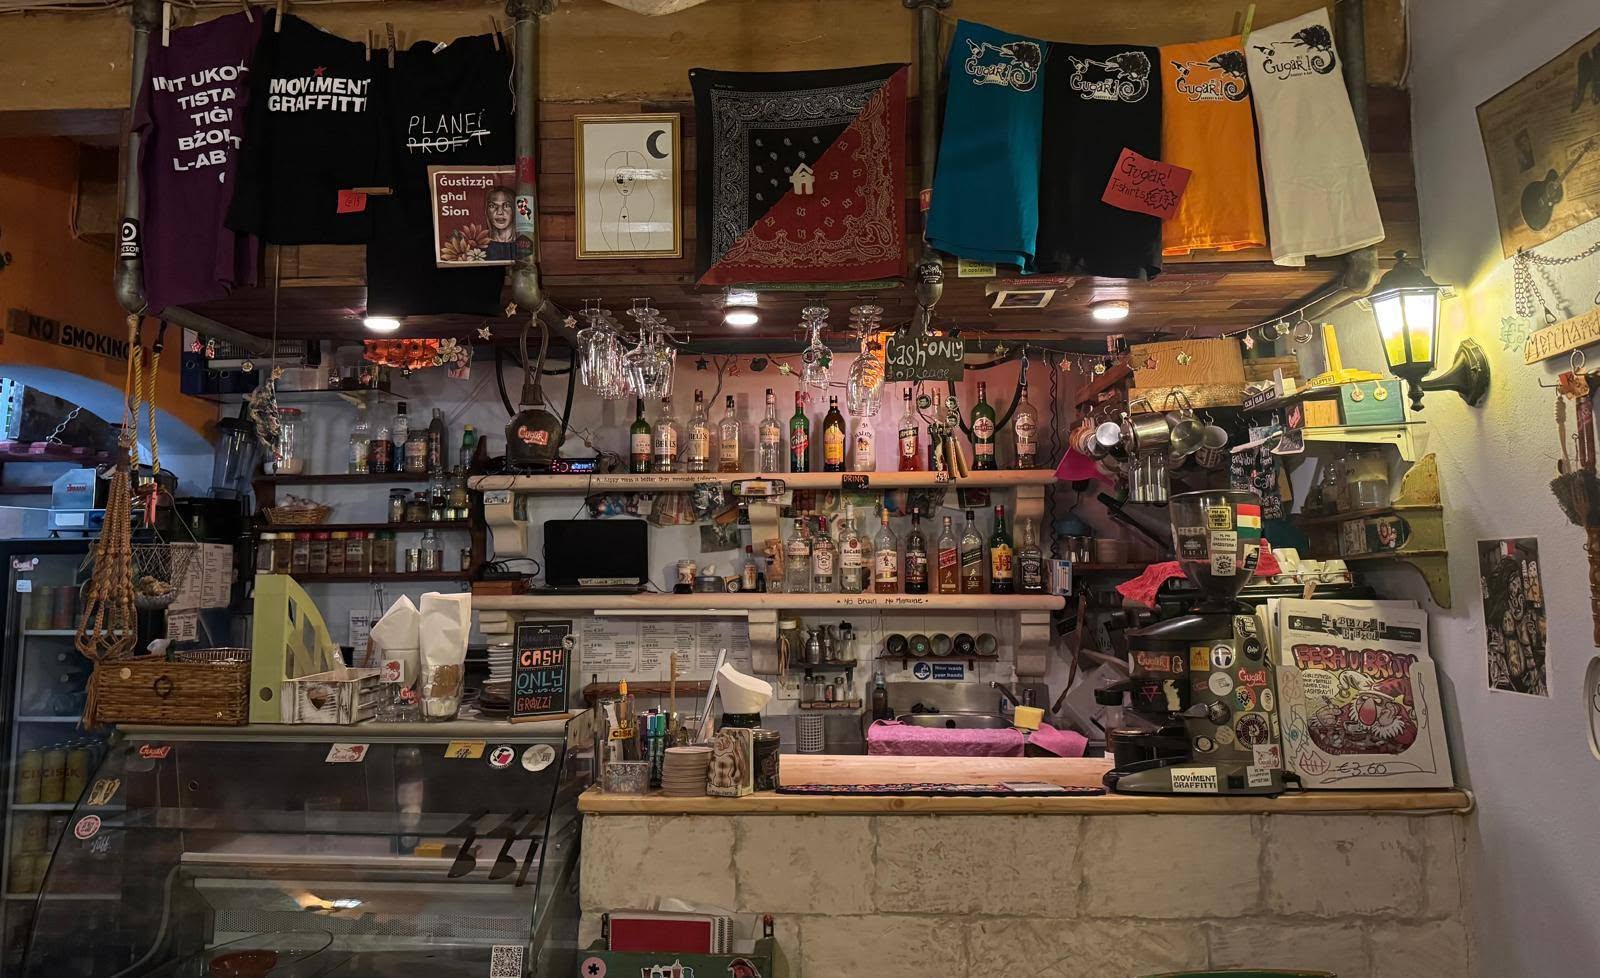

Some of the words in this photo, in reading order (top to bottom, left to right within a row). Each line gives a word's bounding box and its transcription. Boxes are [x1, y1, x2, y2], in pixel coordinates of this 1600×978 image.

[439, 175, 494, 189] Ġustizzja
[440, 191, 467, 203] għal
[441, 206, 470, 217] Sion
[28, 316, 54, 339] NO
[886, 337, 926, 367] Cash
[521, 650, 562, 666] CASH
[517, 669, 563, 689] ONLY
[612, 729, 632, 738] CISK
